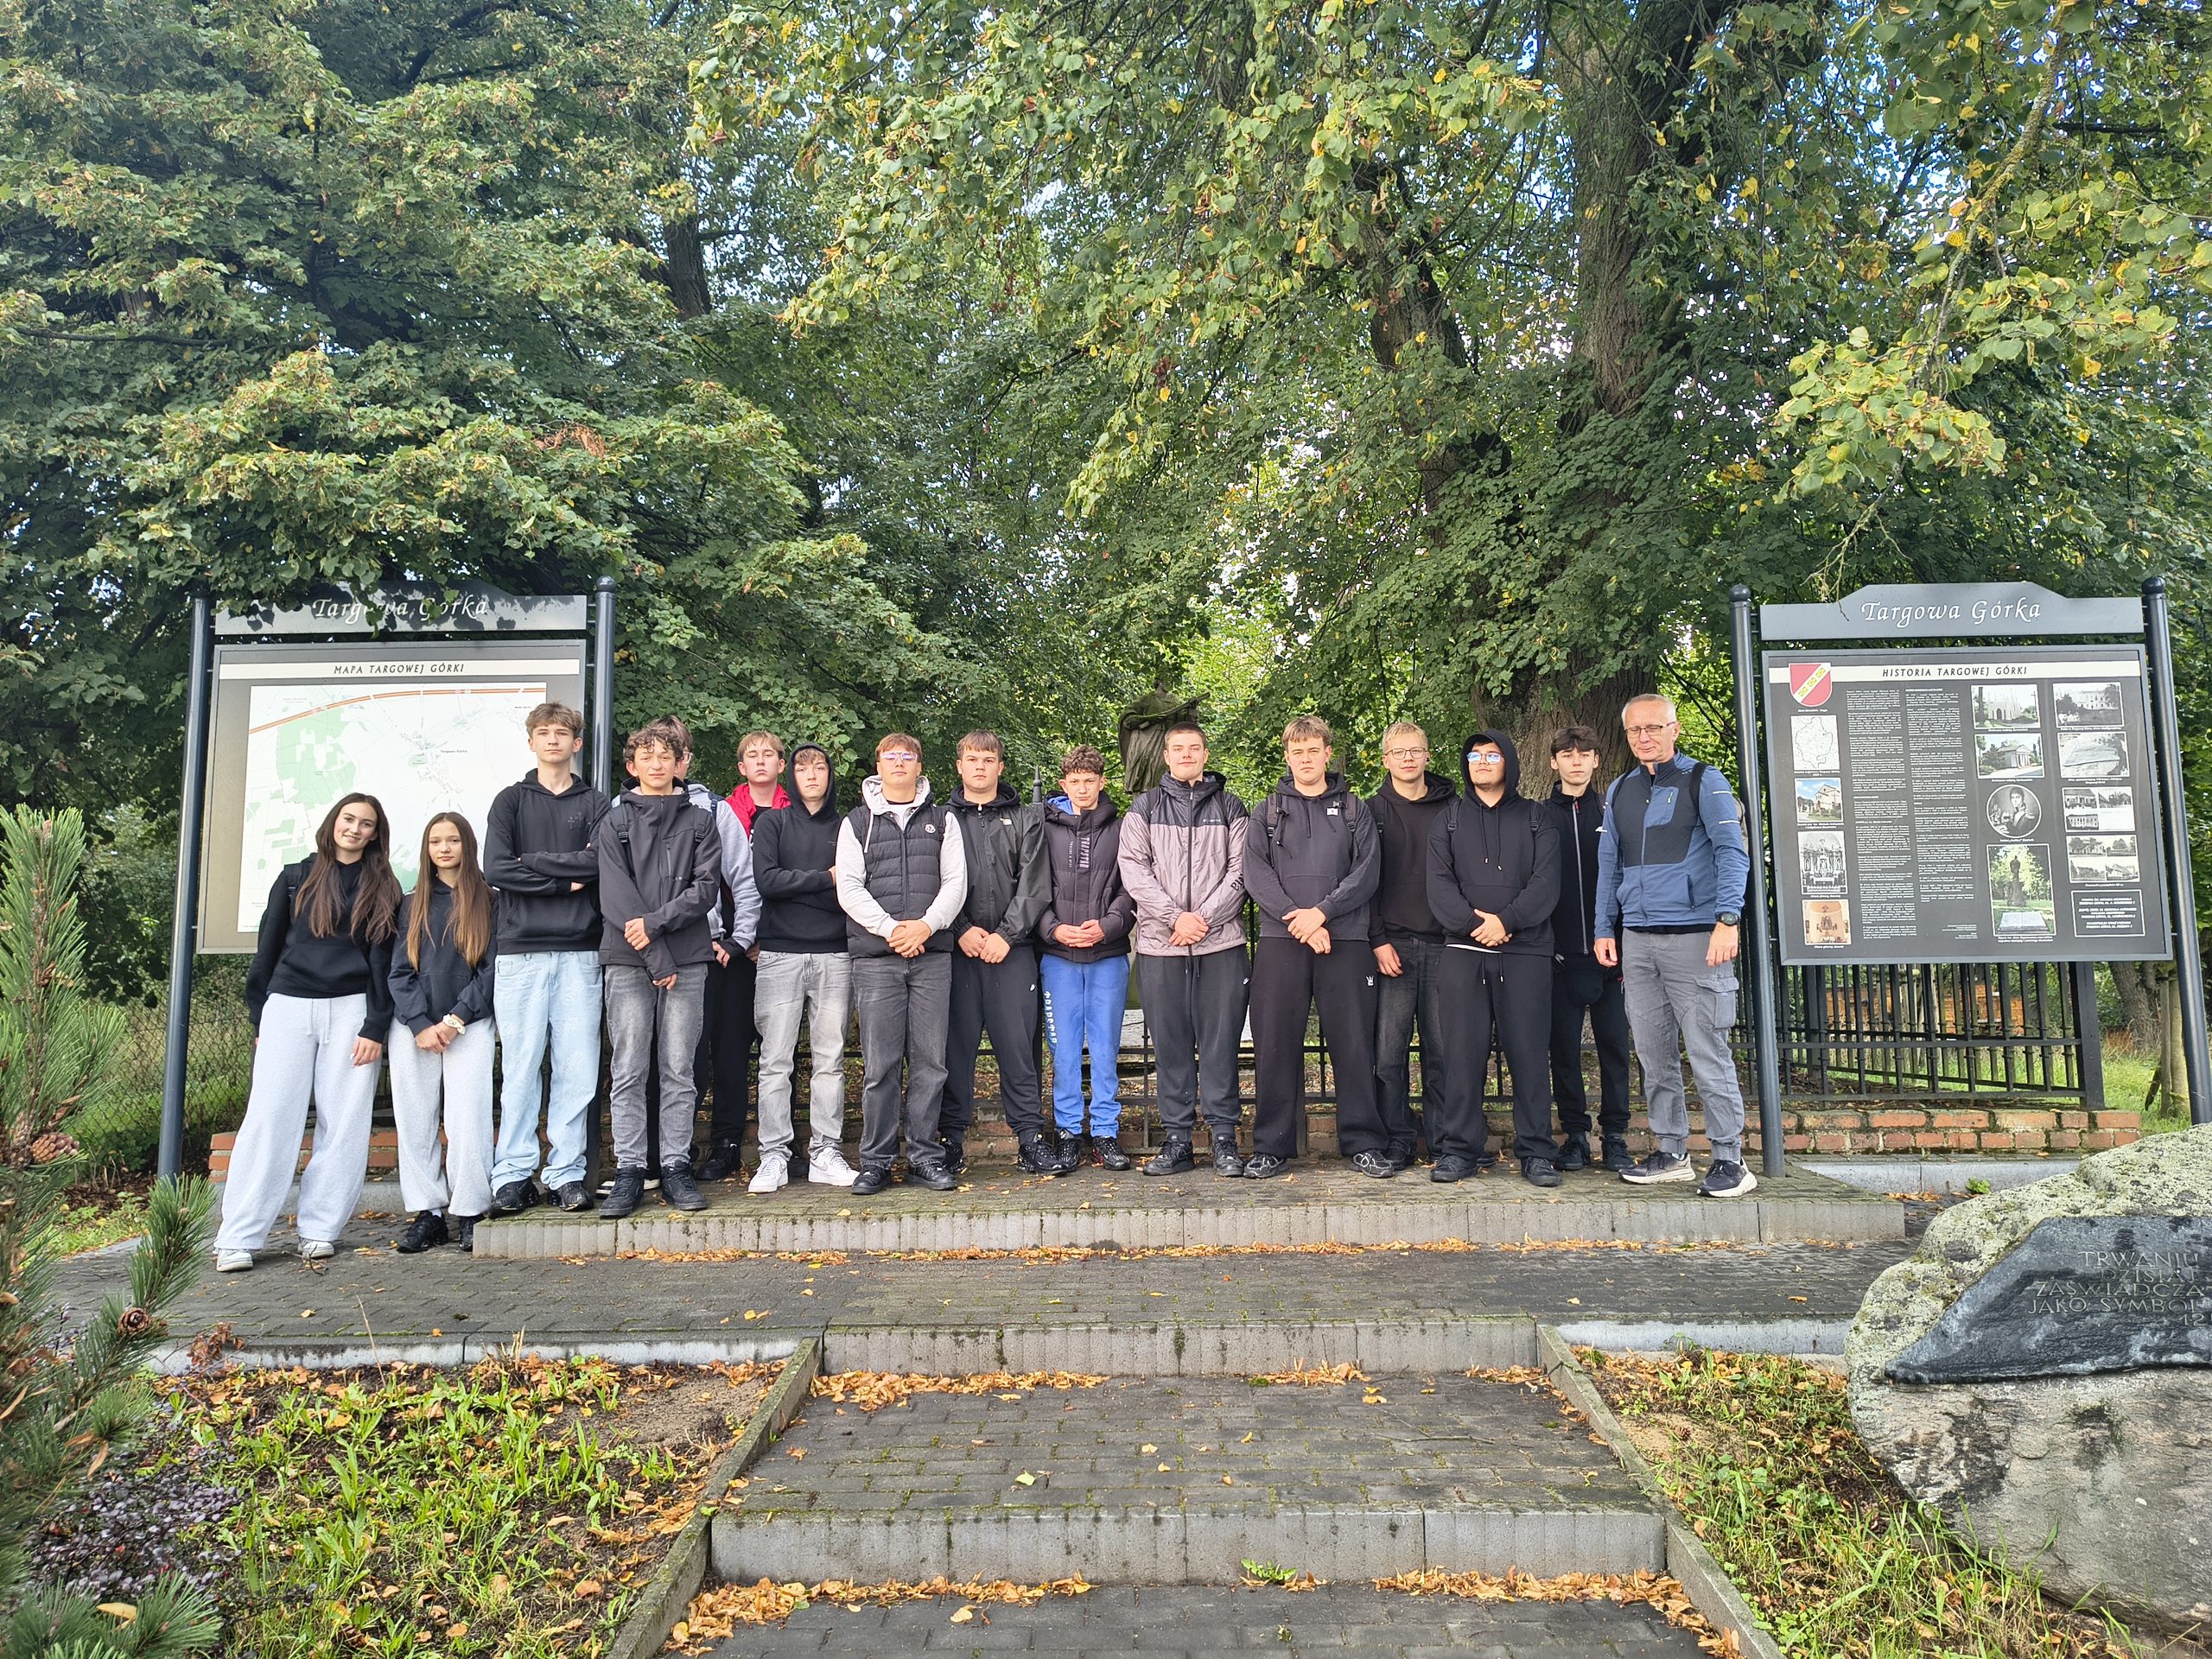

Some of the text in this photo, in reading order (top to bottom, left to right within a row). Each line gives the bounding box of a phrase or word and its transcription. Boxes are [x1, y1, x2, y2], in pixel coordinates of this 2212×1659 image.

[1860, 596, 2042, 628] Targowa Górka
[334, 662, 465, 675] MAPA TARGOWEJ GÓRKI
[1882, 665, 2027, 677] HISTORIA TARGOWEJ GÓRKI
[2078, 1251, 2200, 1268] TRWANIU
[2101, 1268, 2196, 1283] DZISIAJ
[2037, 1279, 2212, 1297] ZAŚWIADCZA
[2028, 1297, 2197, 1314] JAKO SYMBOL
